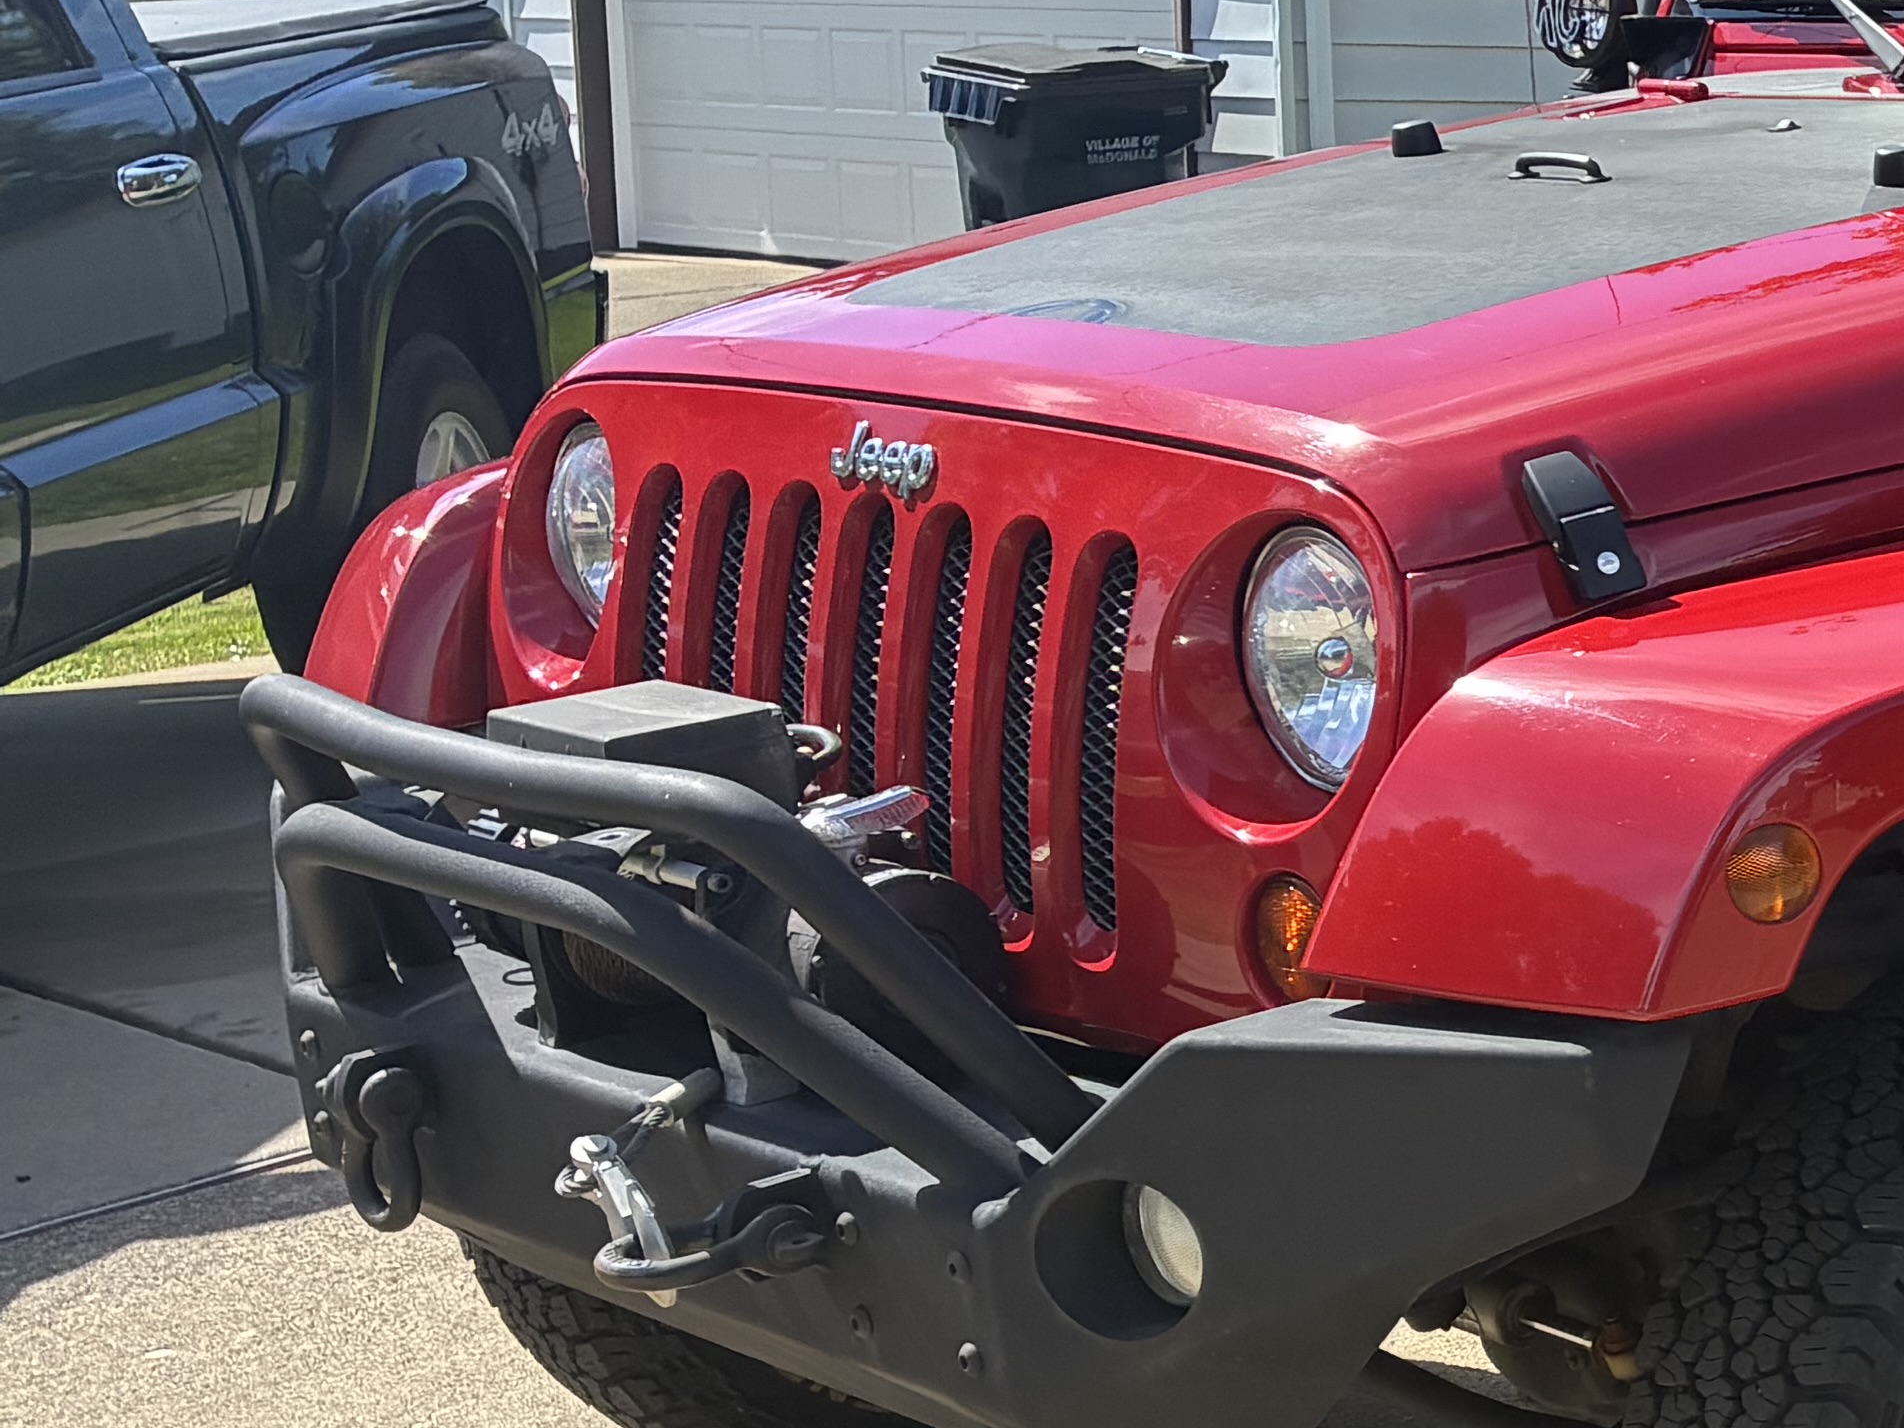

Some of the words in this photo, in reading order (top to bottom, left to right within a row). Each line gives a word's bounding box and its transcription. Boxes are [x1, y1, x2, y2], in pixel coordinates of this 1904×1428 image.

[501, 103, 559, 157] 4x4
[1085, 136, 1140, 151] VILLAGE
[1142, 135, 1160, 147] OF
[831, 420, 934, 500] Jeep
